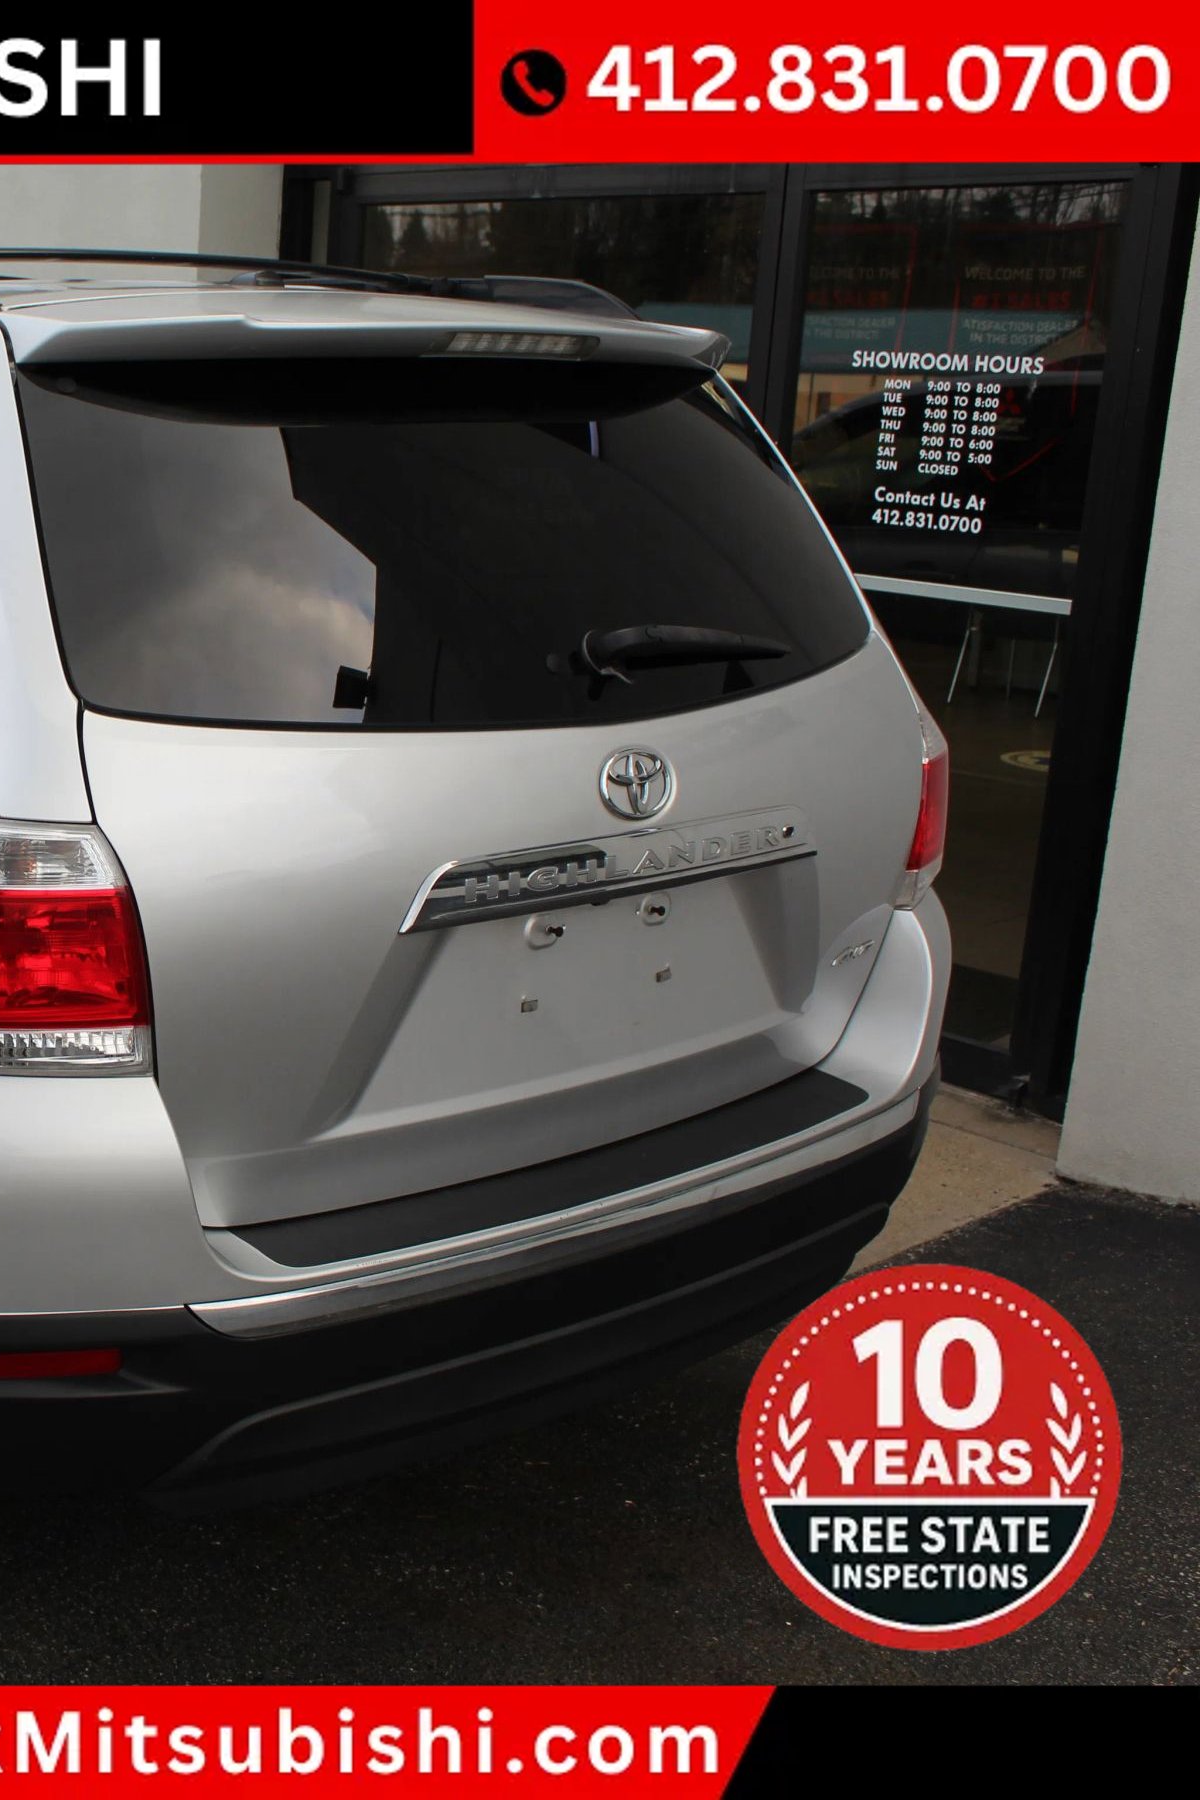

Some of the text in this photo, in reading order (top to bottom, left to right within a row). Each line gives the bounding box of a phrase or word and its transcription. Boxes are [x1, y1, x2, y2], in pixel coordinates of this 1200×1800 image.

[852, 350, 1045, 375] SHOWROOM HOURS
[884, 379, 1001, 394] MON 9:00 TO 8:00
[883, 392, 1000, 409] TUE 9:00 TO 8:00
[882, 406, 998, 422] WED 9:00 TO 8:00
[880, 419, 902, 431] THU
[922, 422, 946, 434] 9:00
[951, 424, 966, 435] TO
[970, 425, 996, 436] 8:00
[878, 432, 994, 451] FRI 9:00 TO 6:00
[877, 446, 992, 465] SAT 9:00 TO 5:00
[875, 460, 959, 476] SUN CLOSED
[874, 486, 986, 511] Contact Us At
[871, 508, 982, 534] 412.831.0700
[463, 825, 781, 904] HIGHLANDER
